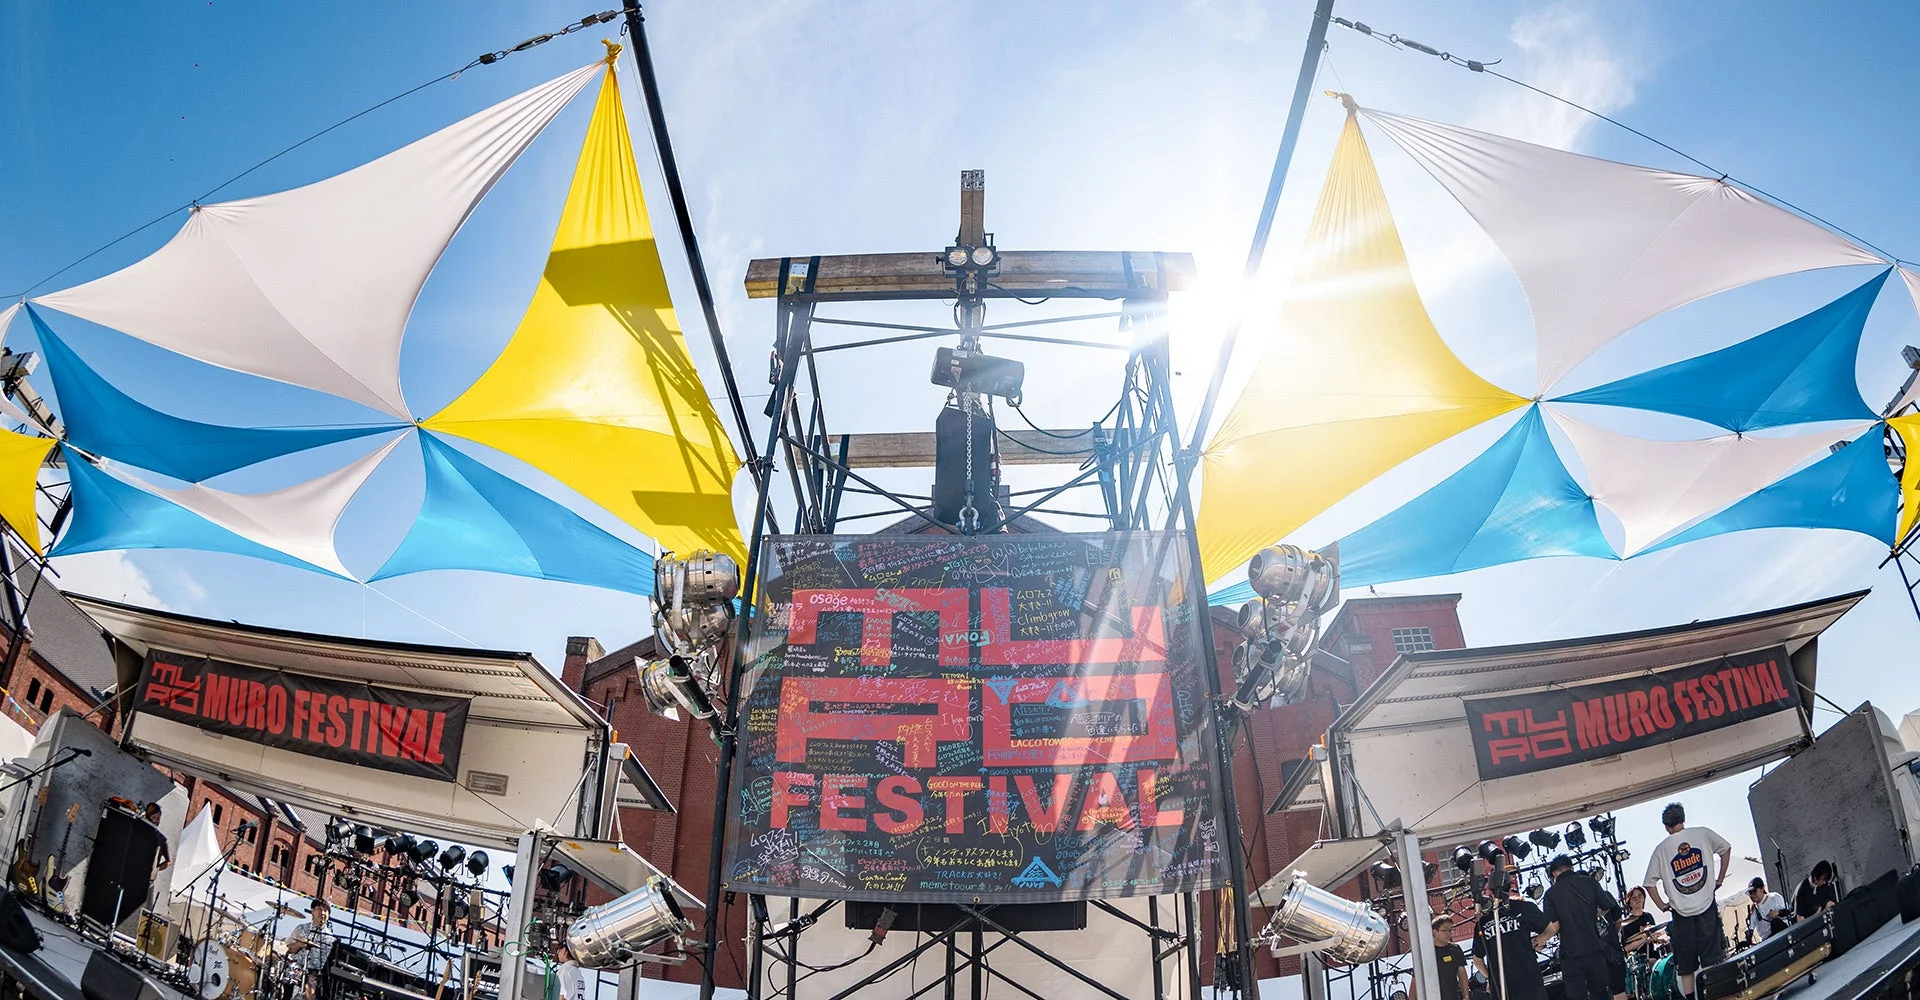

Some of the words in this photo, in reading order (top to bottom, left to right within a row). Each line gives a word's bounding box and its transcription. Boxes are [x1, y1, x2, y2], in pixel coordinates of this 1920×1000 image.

[944, 631, 990, 647] FOMA
[1572, 686, 1677, 750] MURO
[1673, 660, 1789, 723] FESTIVAL
[202, 672, 287, 735] MURO
[292, 689, 446, 765] FESTIVAL
[1011, 740, 1041, 748] LACCO
[990, 765, 1010, 776] GOOD
[1012, 765, 1022, 775] ON
[927, 779, 949, 789] GOOD
[769, 769, 1185, 833] FESTIVAL
[1673, 852, 1701, 872] Rhude
[801, 865, 830, 885] 35.7
[885, 872, 907, 883] Candy
[1681, 871, 1702, 884] CIGARS
